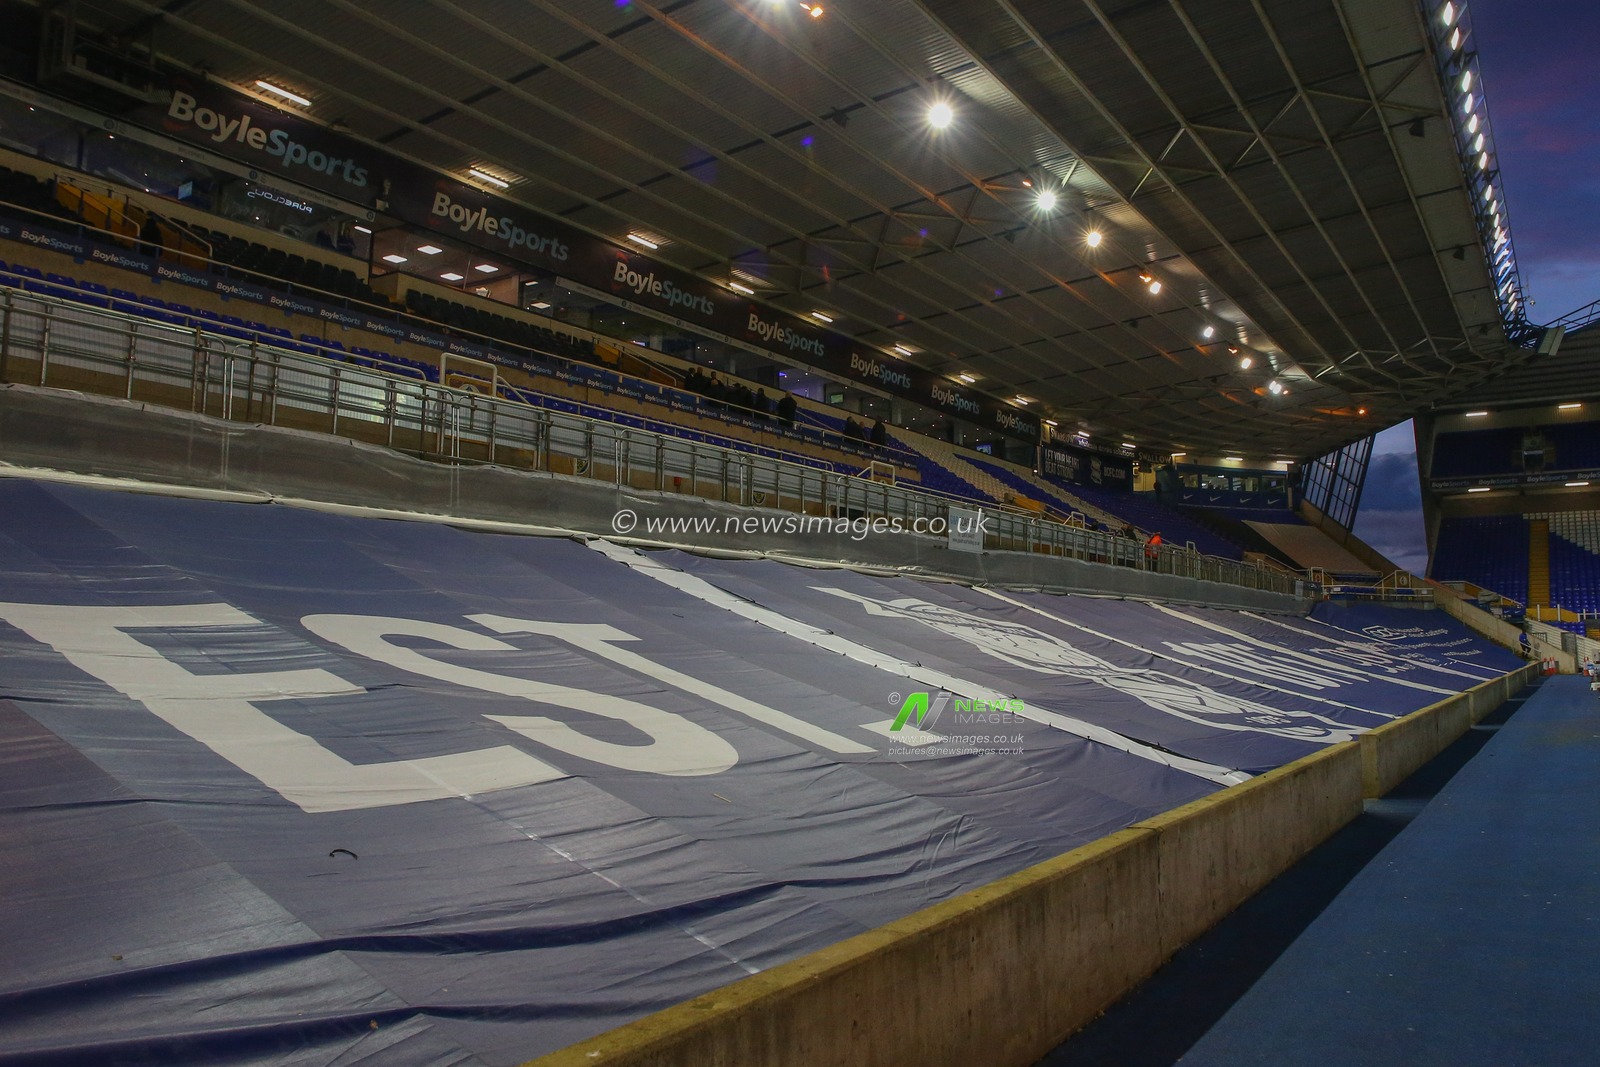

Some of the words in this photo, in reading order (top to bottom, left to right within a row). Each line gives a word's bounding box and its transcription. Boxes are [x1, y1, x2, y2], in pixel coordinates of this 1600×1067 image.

[168, 90, 369, 187] BoyleSports
[431, 192, 568, 262] BoyleSports
[20, 230, 83, 253] BoyleSports
[92, 249, 149, 271] BoyleSports
[157, 266, 209, 286] BoyleSports
[216, 281, 264, 300] BoyleSports
[614, 261, 714, 316] BoyleSports
[270, 296, 314, 313] BoyleSports
[320, 309, 361, 326] BoyleSports
[366, 321, 404, 337] BoyleSports
[748, 313, 825, 357] BoyleSports
[409, 332, 445, 348] BoyleSports
[450, 343, 483, 357] BoyleSports
[487, 353, 519, 367] BoyleSports
[850, 353, 911, 390] BoyleSports
[931, 384, 980, 415] BoyleSports
[996, 409, 1036, 435] BoyleSports
[1138, 451, 1172, 463] SWALLOW
